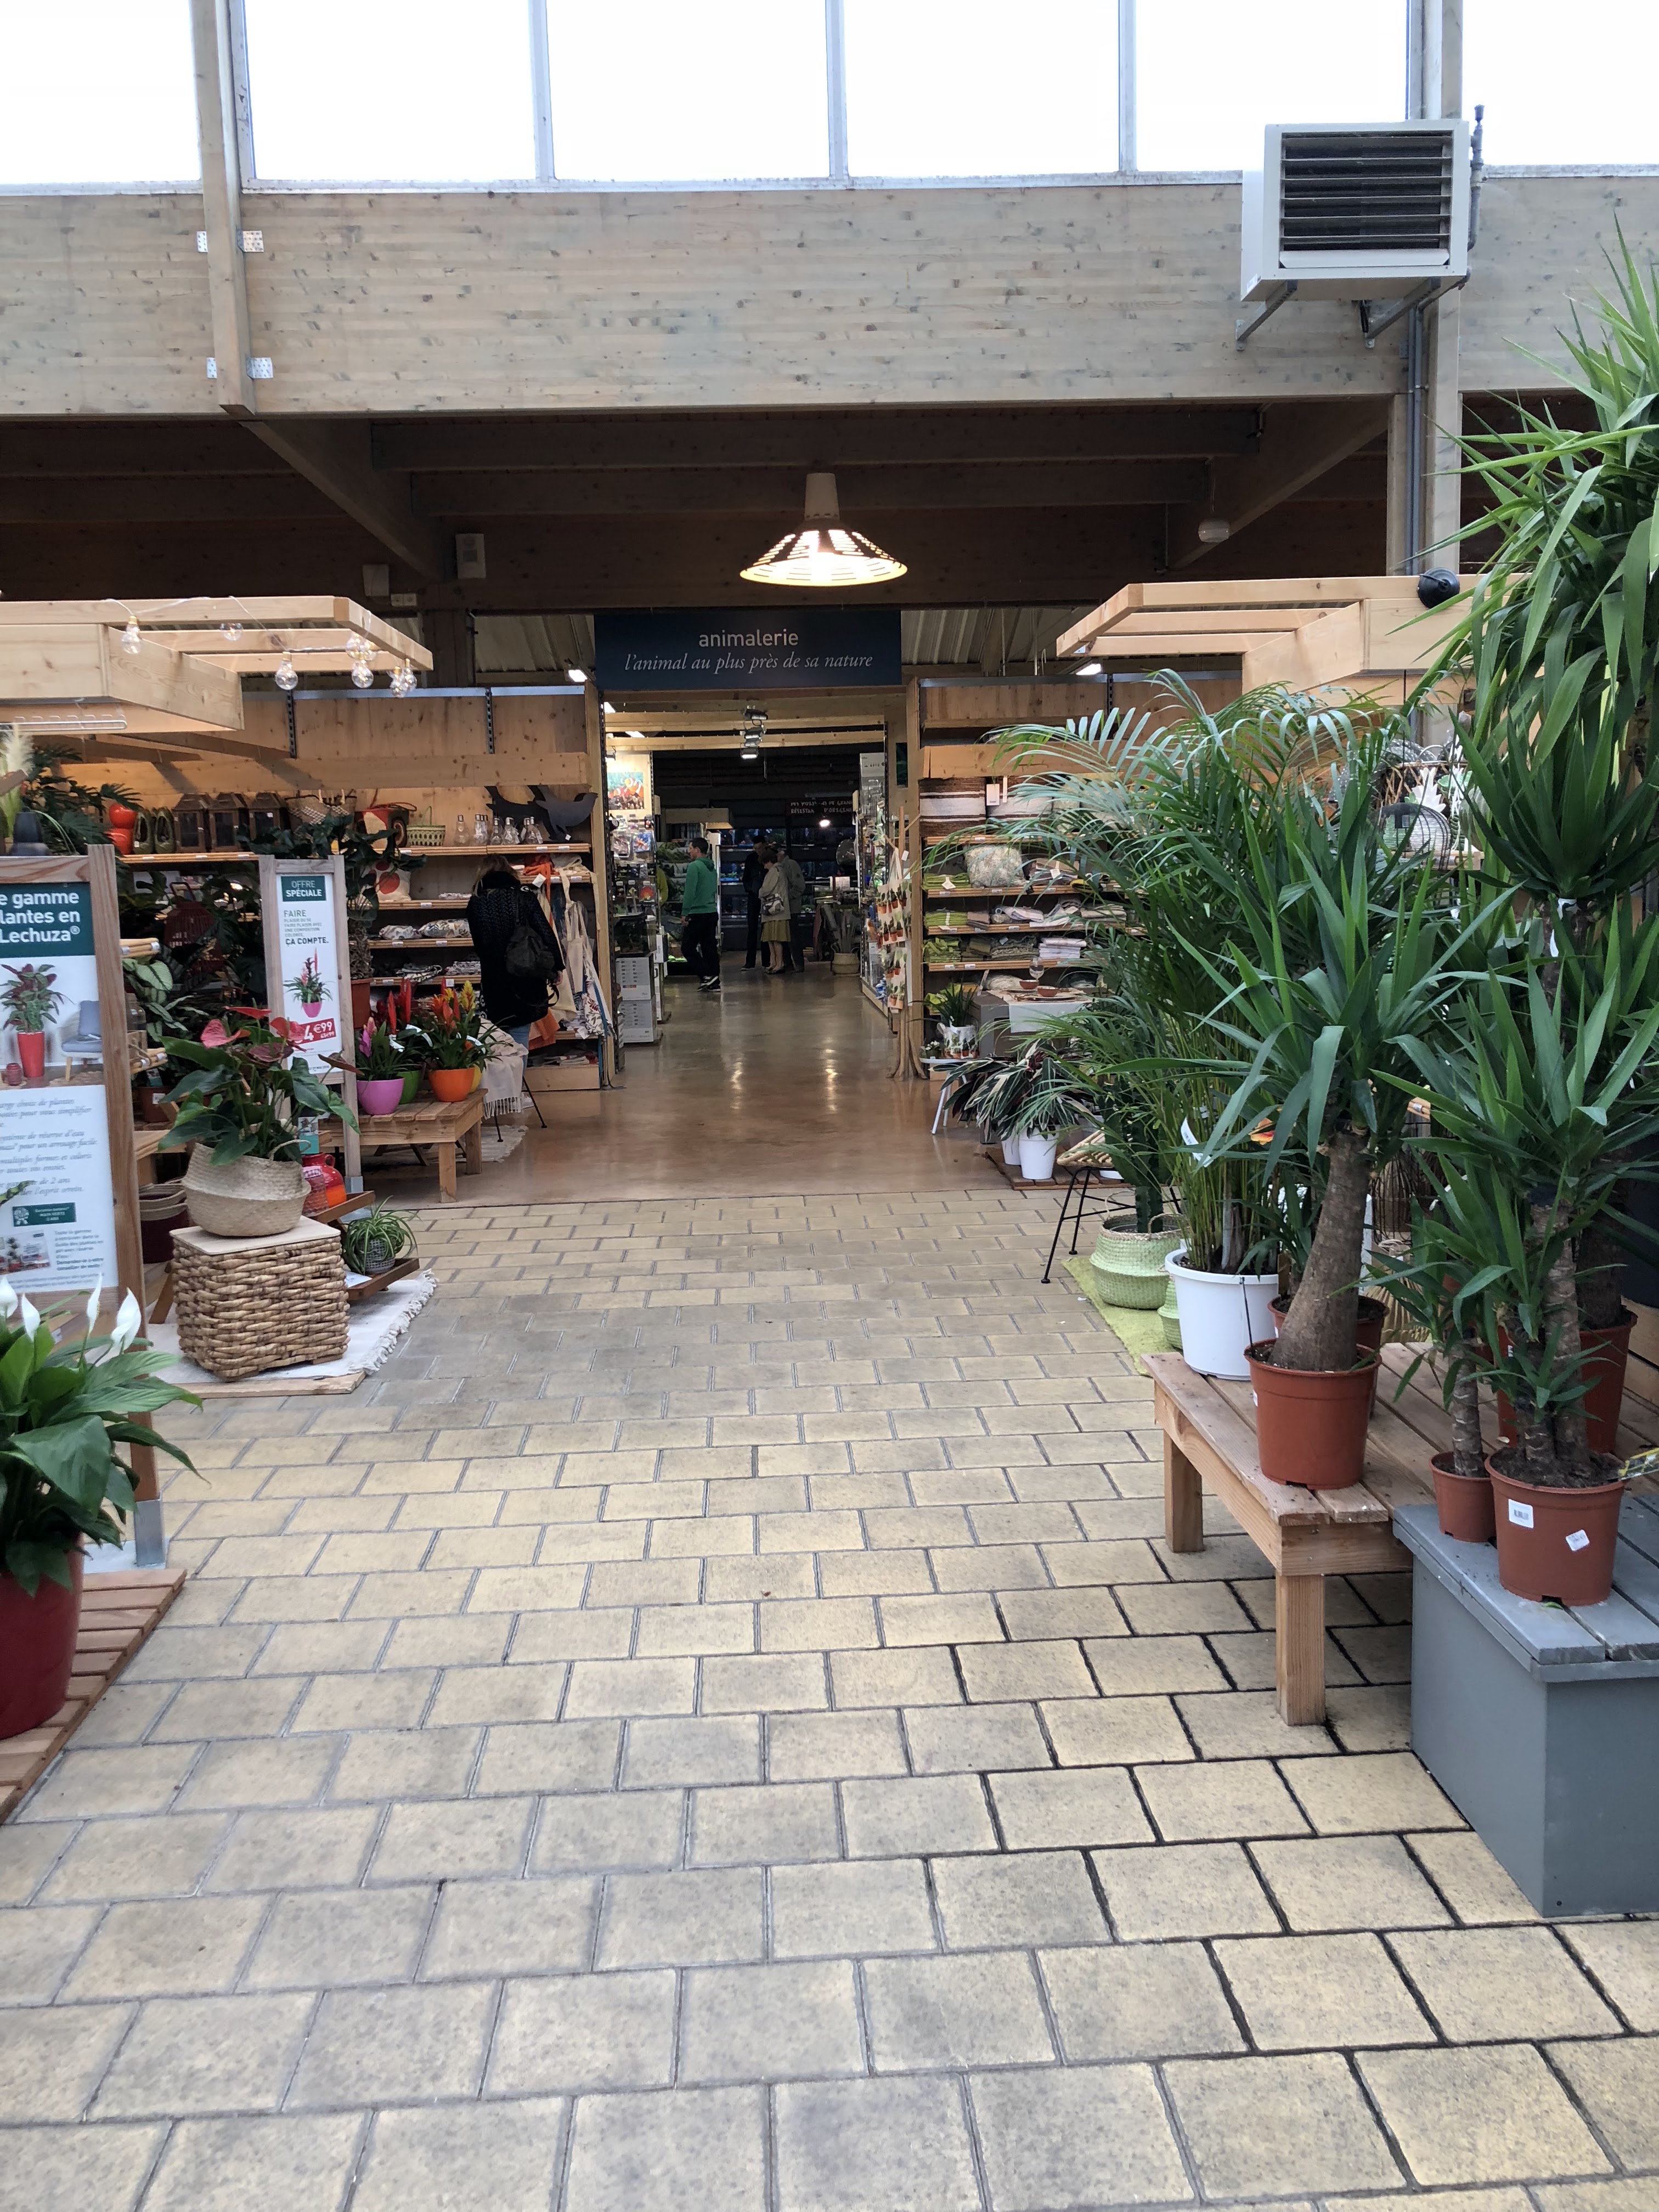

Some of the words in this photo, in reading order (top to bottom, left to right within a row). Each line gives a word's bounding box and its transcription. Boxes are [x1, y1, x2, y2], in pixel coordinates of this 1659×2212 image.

[699, 629, 798, 647] animalerie
[625, 653, 688, 670] l'animal
[691, 658, 711, 669] au
[714, 652, 745, 674] plus
[748, 653, 778, 674] près
[783, 651, 800, 668] de
[804, 657, 819, 668] sa
[825, 655, 873, 668] nature
[291, 880, 315, 888] OFFRE
[286, 888, 323, 897] SPÉCIALE
[12, 893, 80, 909] gamme
[59, 911, 81, 923] en
[285, 938, 296, 946] ÇA
